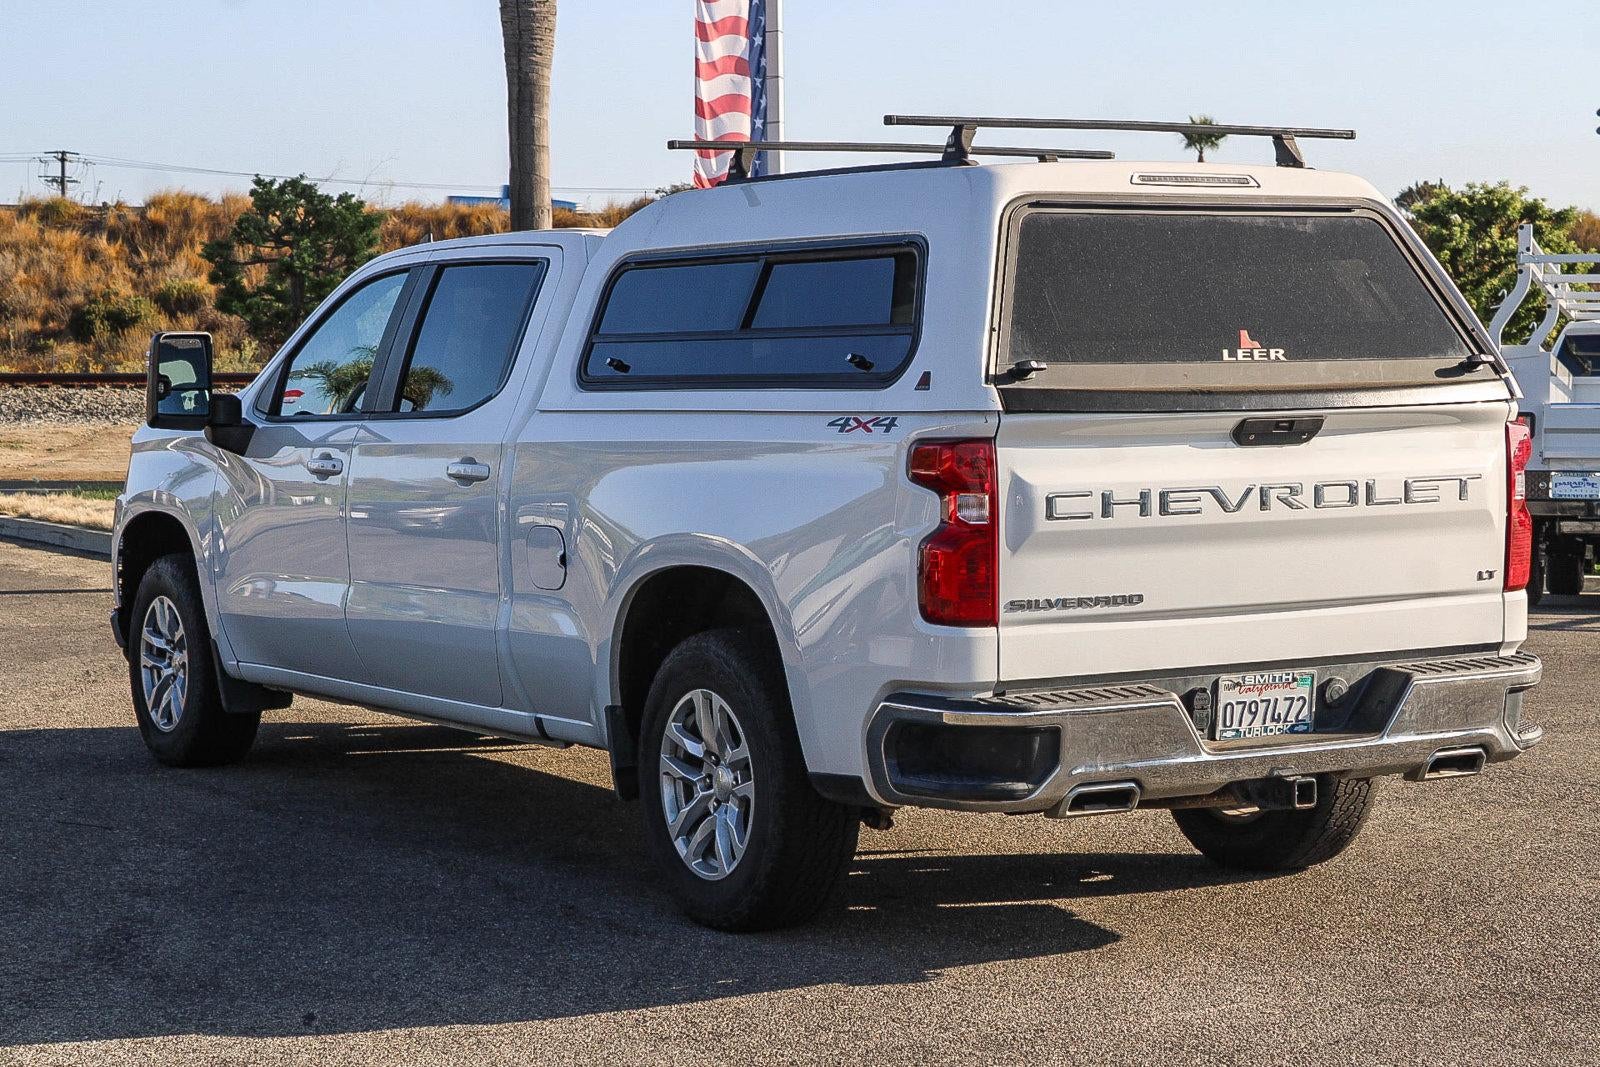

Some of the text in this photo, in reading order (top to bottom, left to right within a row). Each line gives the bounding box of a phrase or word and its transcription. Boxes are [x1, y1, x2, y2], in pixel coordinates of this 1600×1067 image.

[1222, 348, 1287, 361] LEER
[1045, 473, 1482, 521] CHEVROLET
[1477, 569, 1498, 581] LT
[1003, 593, 1144, 613] SILVERADO
[1245, 672, 1293, 684] SMITH
[1238, 682, 1297, 696] California
[1239, 725, 1290, 737] TURLOCK
